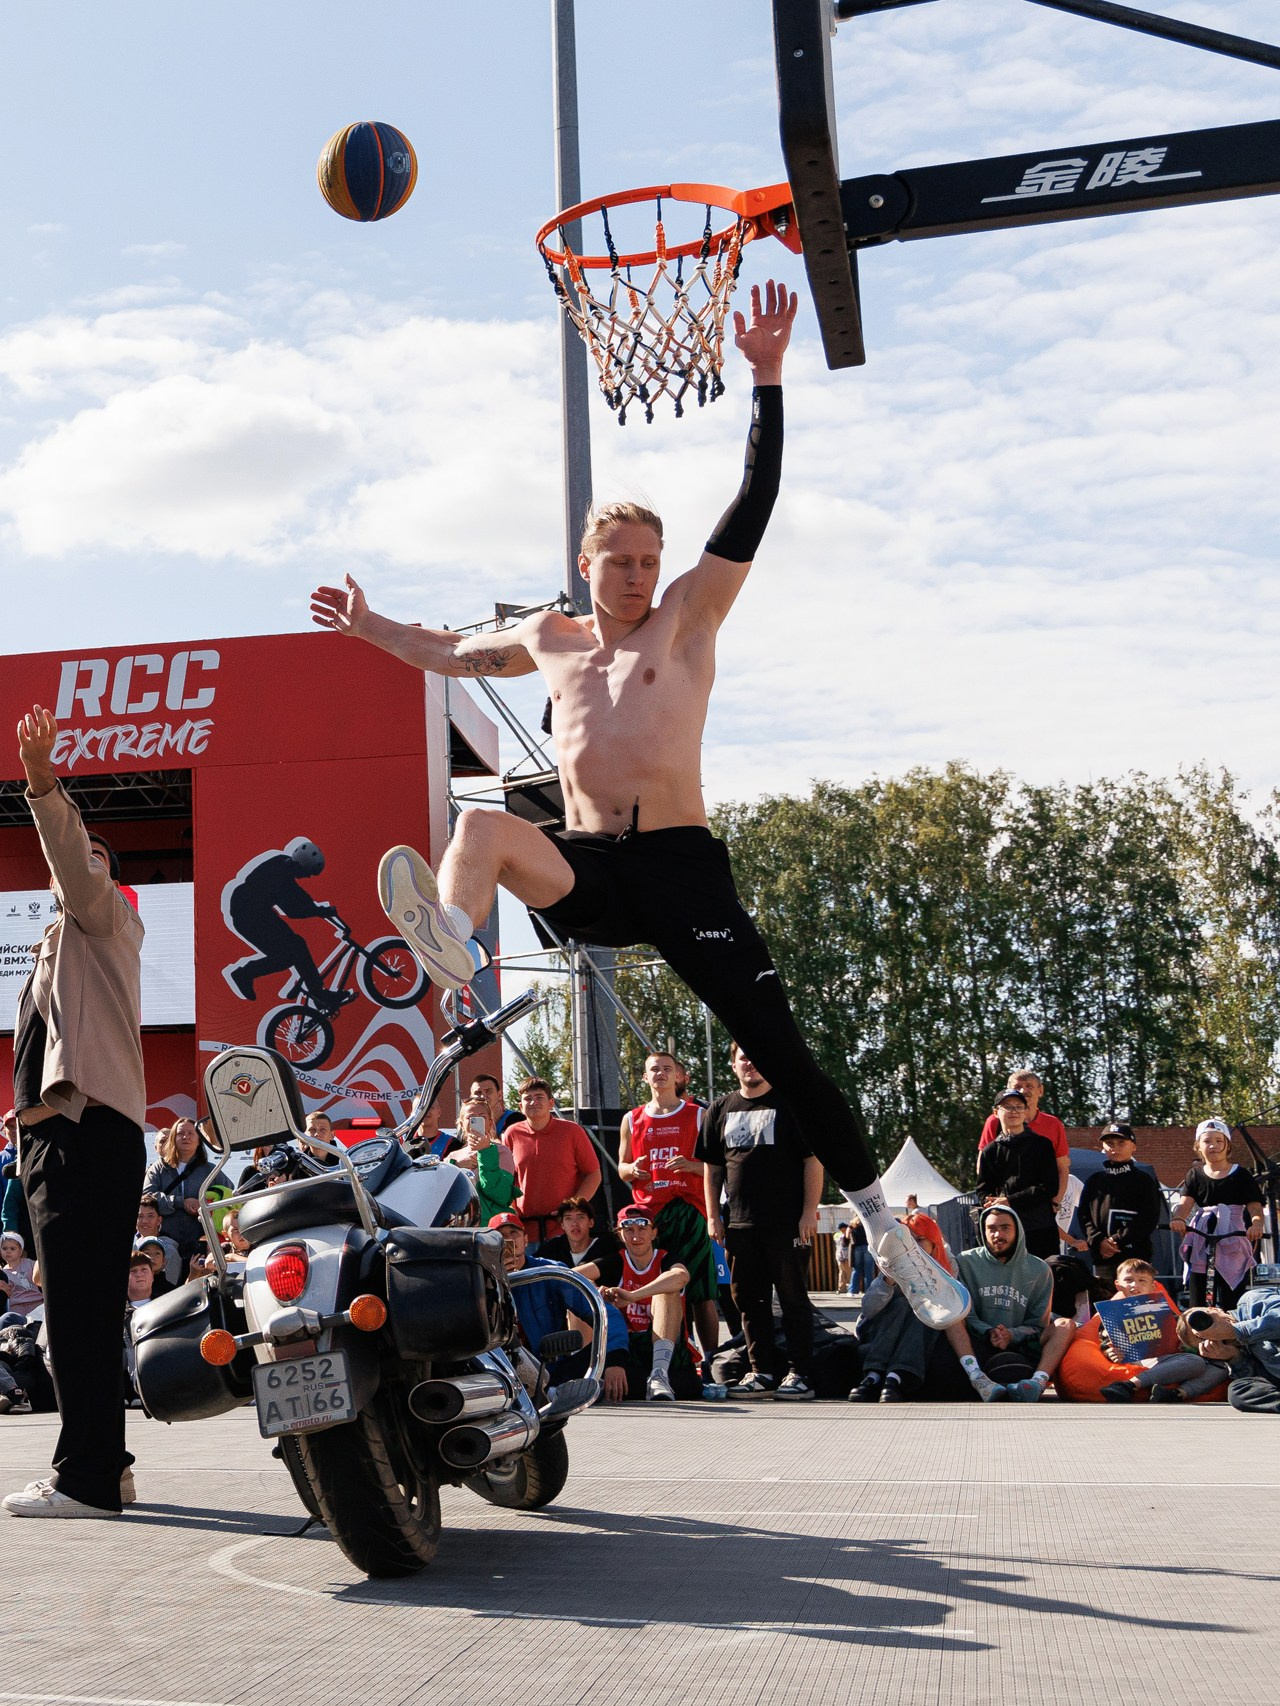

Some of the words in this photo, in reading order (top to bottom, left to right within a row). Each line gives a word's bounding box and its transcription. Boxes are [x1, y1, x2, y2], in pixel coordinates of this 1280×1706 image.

[1015, 147, 1168, 197] 金陵
[55, 650, 220, 719] RCC
[49, 719, 215, 771] EXTREME
[699, 930, 727, 939] ASRV
[295, 1070, 317, 1086] 2025
[323, 1083, 344, 1097] RCC
[345, 1088, 392, 1101] EXTREME
[650, 1146, 680, 1161] RCC
[793, 1237, 812, 1248] PUA
[718, 1264, 725, 1277] 3
[1122, 1314, 1158, 1335] RCC
[1128, 1329, 1162, 1344] EXTREME
[267, 1358, 334, 1389] 6252
[303, 1382, 325, 1392] RUS
[313, 1388, 345, 1412] 66
